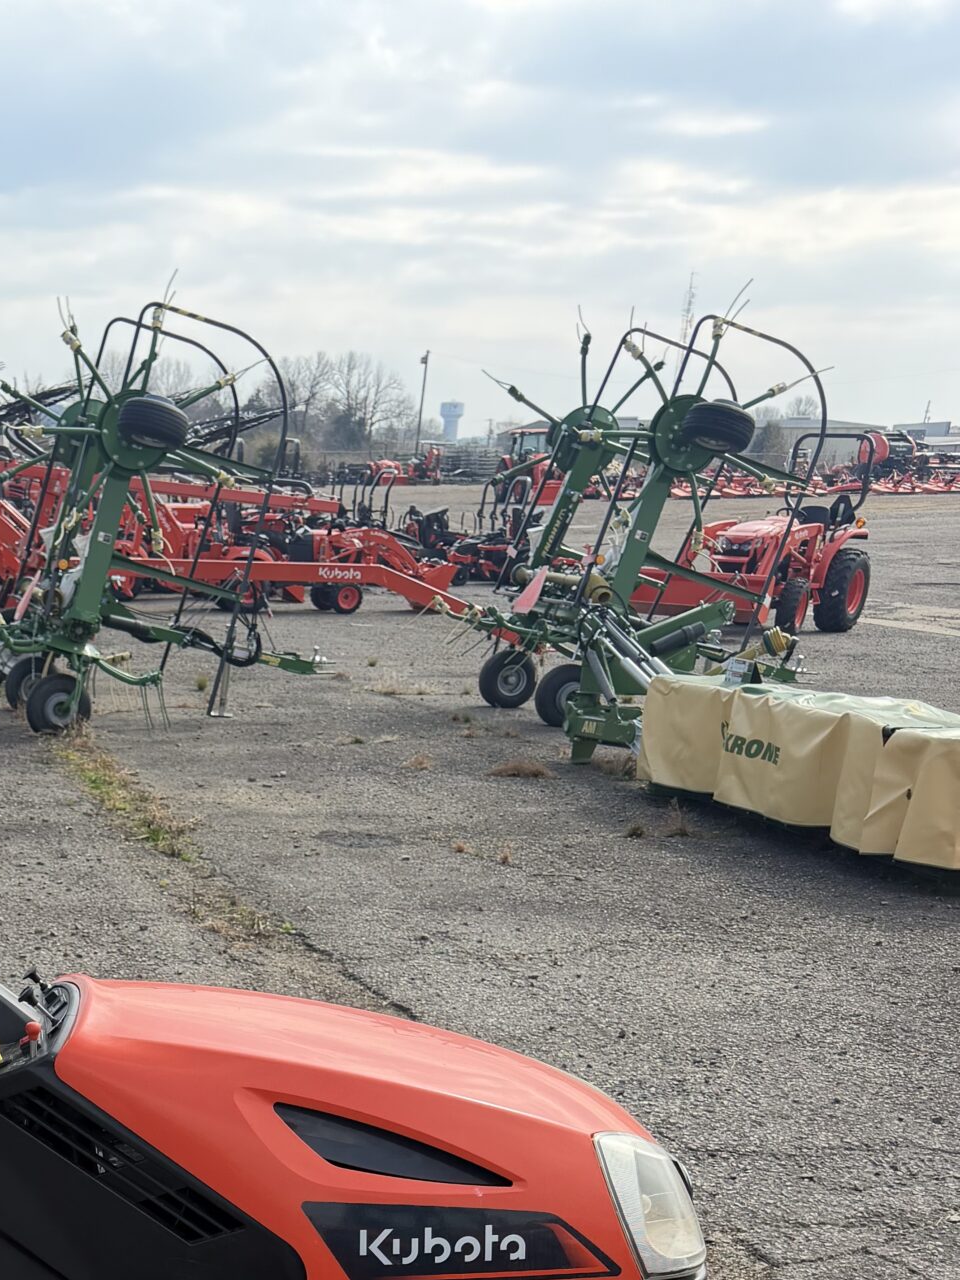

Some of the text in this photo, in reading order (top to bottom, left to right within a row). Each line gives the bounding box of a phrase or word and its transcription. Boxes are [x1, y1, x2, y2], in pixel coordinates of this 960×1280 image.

[318, 567, 362, 579] Kubota
[722, 733, 781, 766] KRONE
[359, 1224, 527, 1266] Kubota
